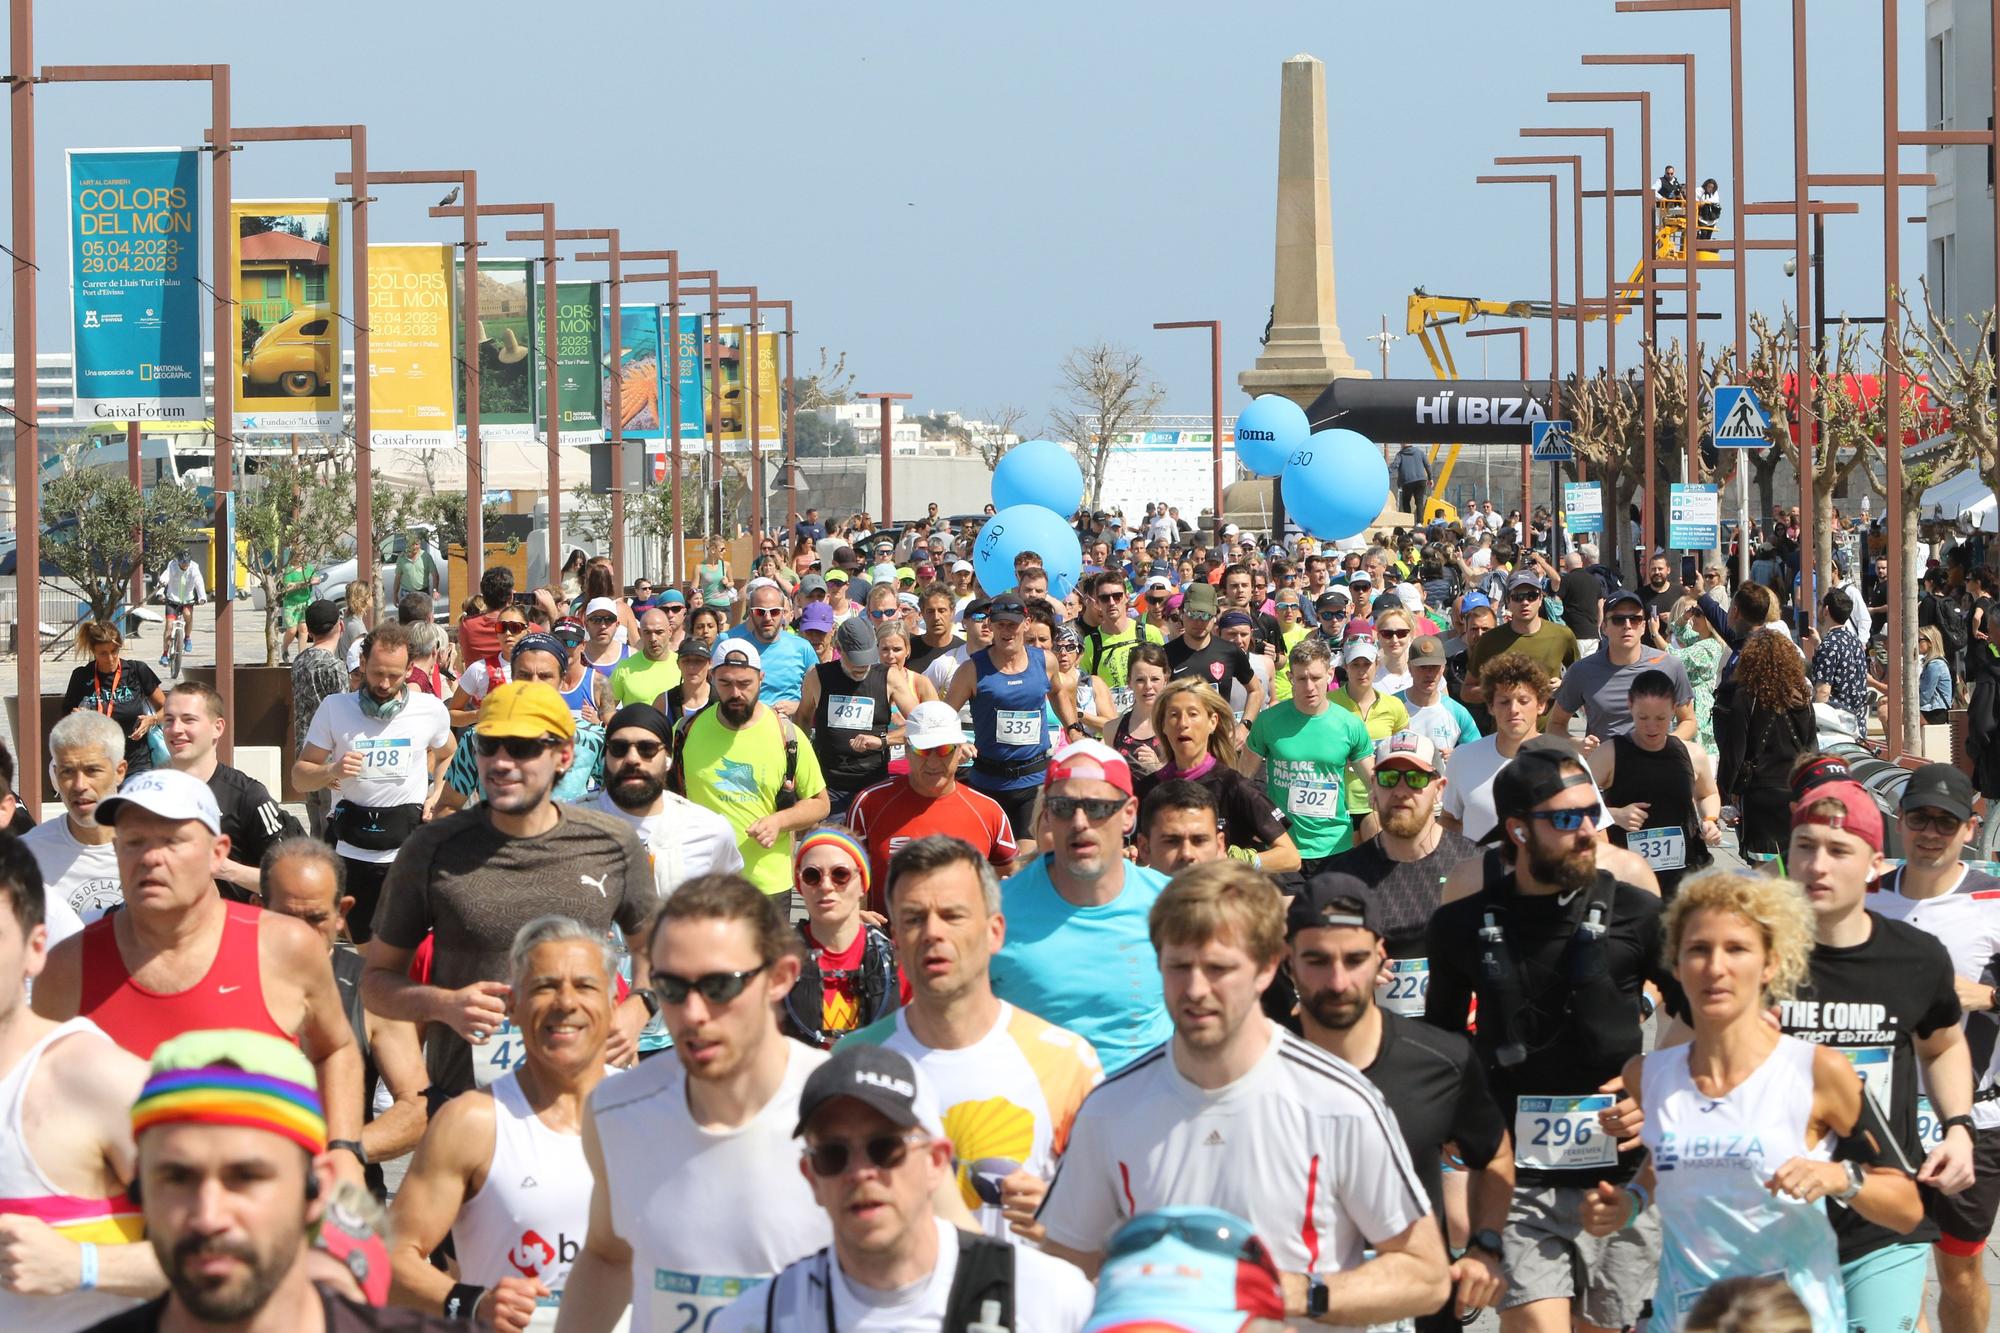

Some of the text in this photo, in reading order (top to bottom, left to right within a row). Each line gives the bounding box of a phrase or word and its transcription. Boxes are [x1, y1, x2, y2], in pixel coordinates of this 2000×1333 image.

[80, 188, 187, 211] COLORS
[81, 213, 128, 235] DEL
[82, 239, 184, 256] 05.04.2023-
[82, 256, 177, 272] 29.04.2023
[83, 280, 108, 288] Carrer
[140, 279, 154, 287] Tur
[159, 278, 180, 286] Palau
[98, 369, 125, 377] exposició
[153, 371, 192, 379] GEOGRAPHIC
[94, 402, 185, 418] CaixaForum
[1457, 396, 1547, 425] IBIZA
[261, 416, 296, 426] Fundació
[372, 433, 441, 446] CaixaForum
[1238, 428, 1275, 442] Joma
[980, 524, 1005, 562] 4:30
[834, 705, 862, 719] 481
[1003, 720, 1032, 734] 335
[366, 749, 399, 768] 198
[1273, 759, 1315, 772] WE ARE
[1295, 790, 1327, 806] 302
[1639, 839, 1671, 858] 331
[83, 881, 98, 896] DE
[100, 880, 114, 890] LA
[1780, 1000, 1820, 1029] THE
[1822, 1002, 1886, 1031] COMP
[1837, 1030, 1896, 1043] EDITION
[1531, 1117, 1594, 1146] 296
[1684, 1135, 1765, 1158] IBIZA
